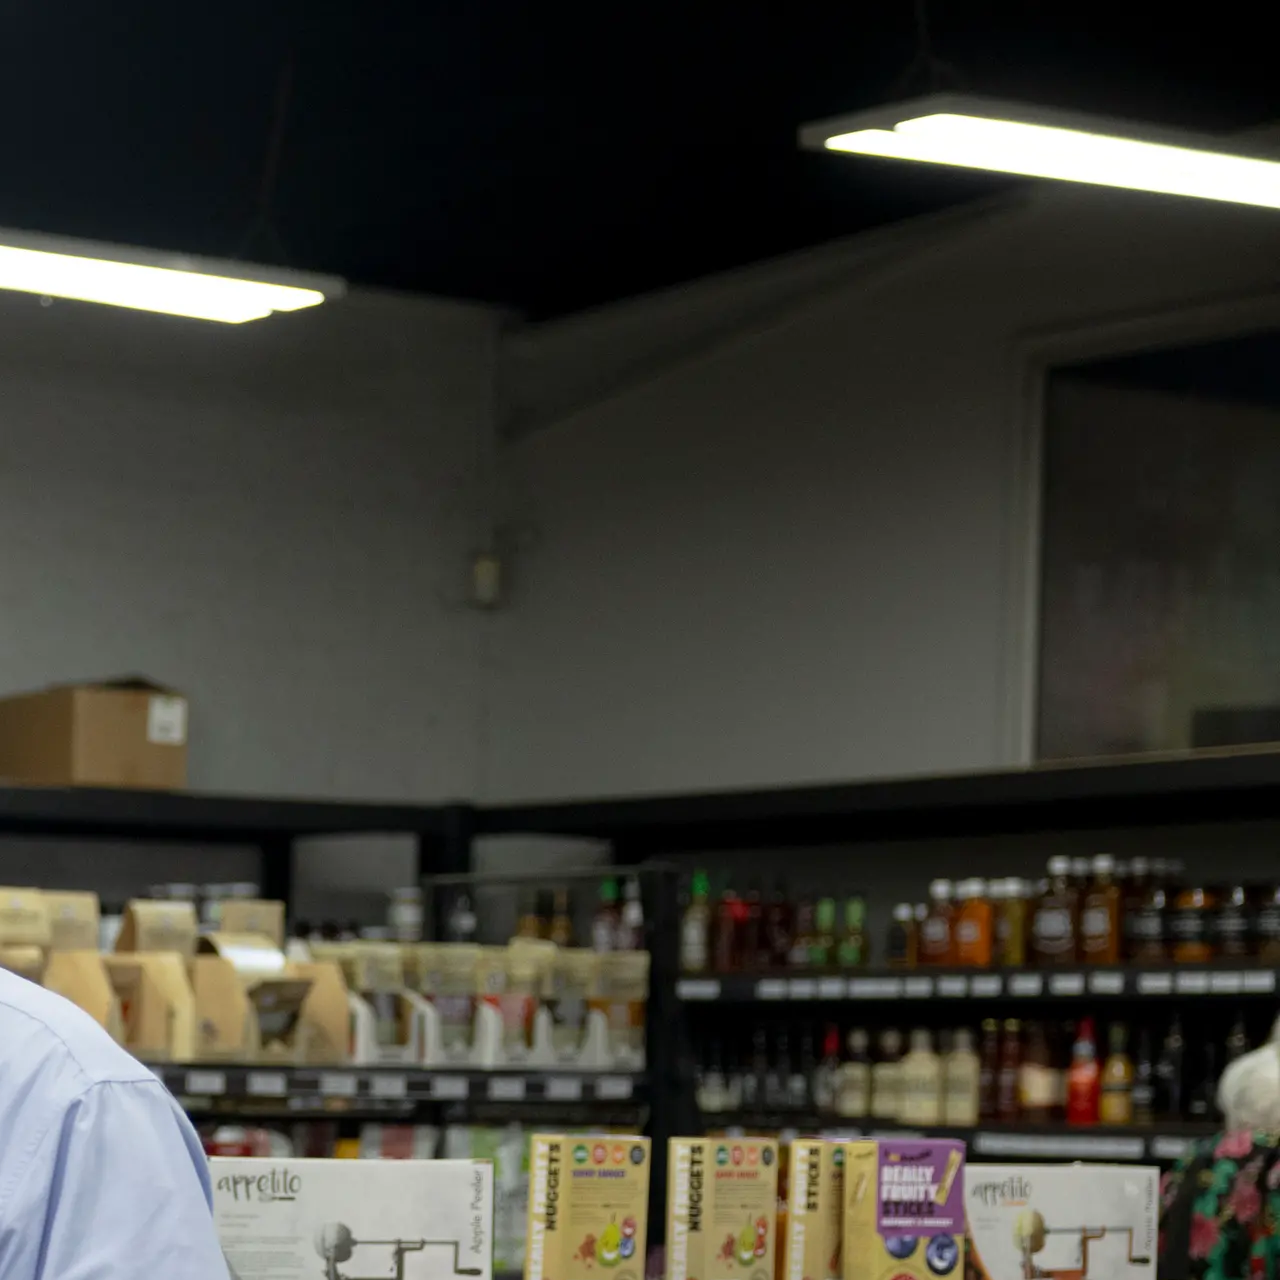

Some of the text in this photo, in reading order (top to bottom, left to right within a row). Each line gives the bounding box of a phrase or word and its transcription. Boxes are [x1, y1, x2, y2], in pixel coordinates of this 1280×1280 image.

[216, 1168, 301, 1200] appetito
[545, 1143, 561, 1231] NUGGETS
[689, 1145, 704, 1232] NUGGETS
[807, 1148, 820, 1212] STICKS
[881, 1165, 935, 1182] REALLY
[470, 1170, 485, 1252] Apple Peeler
